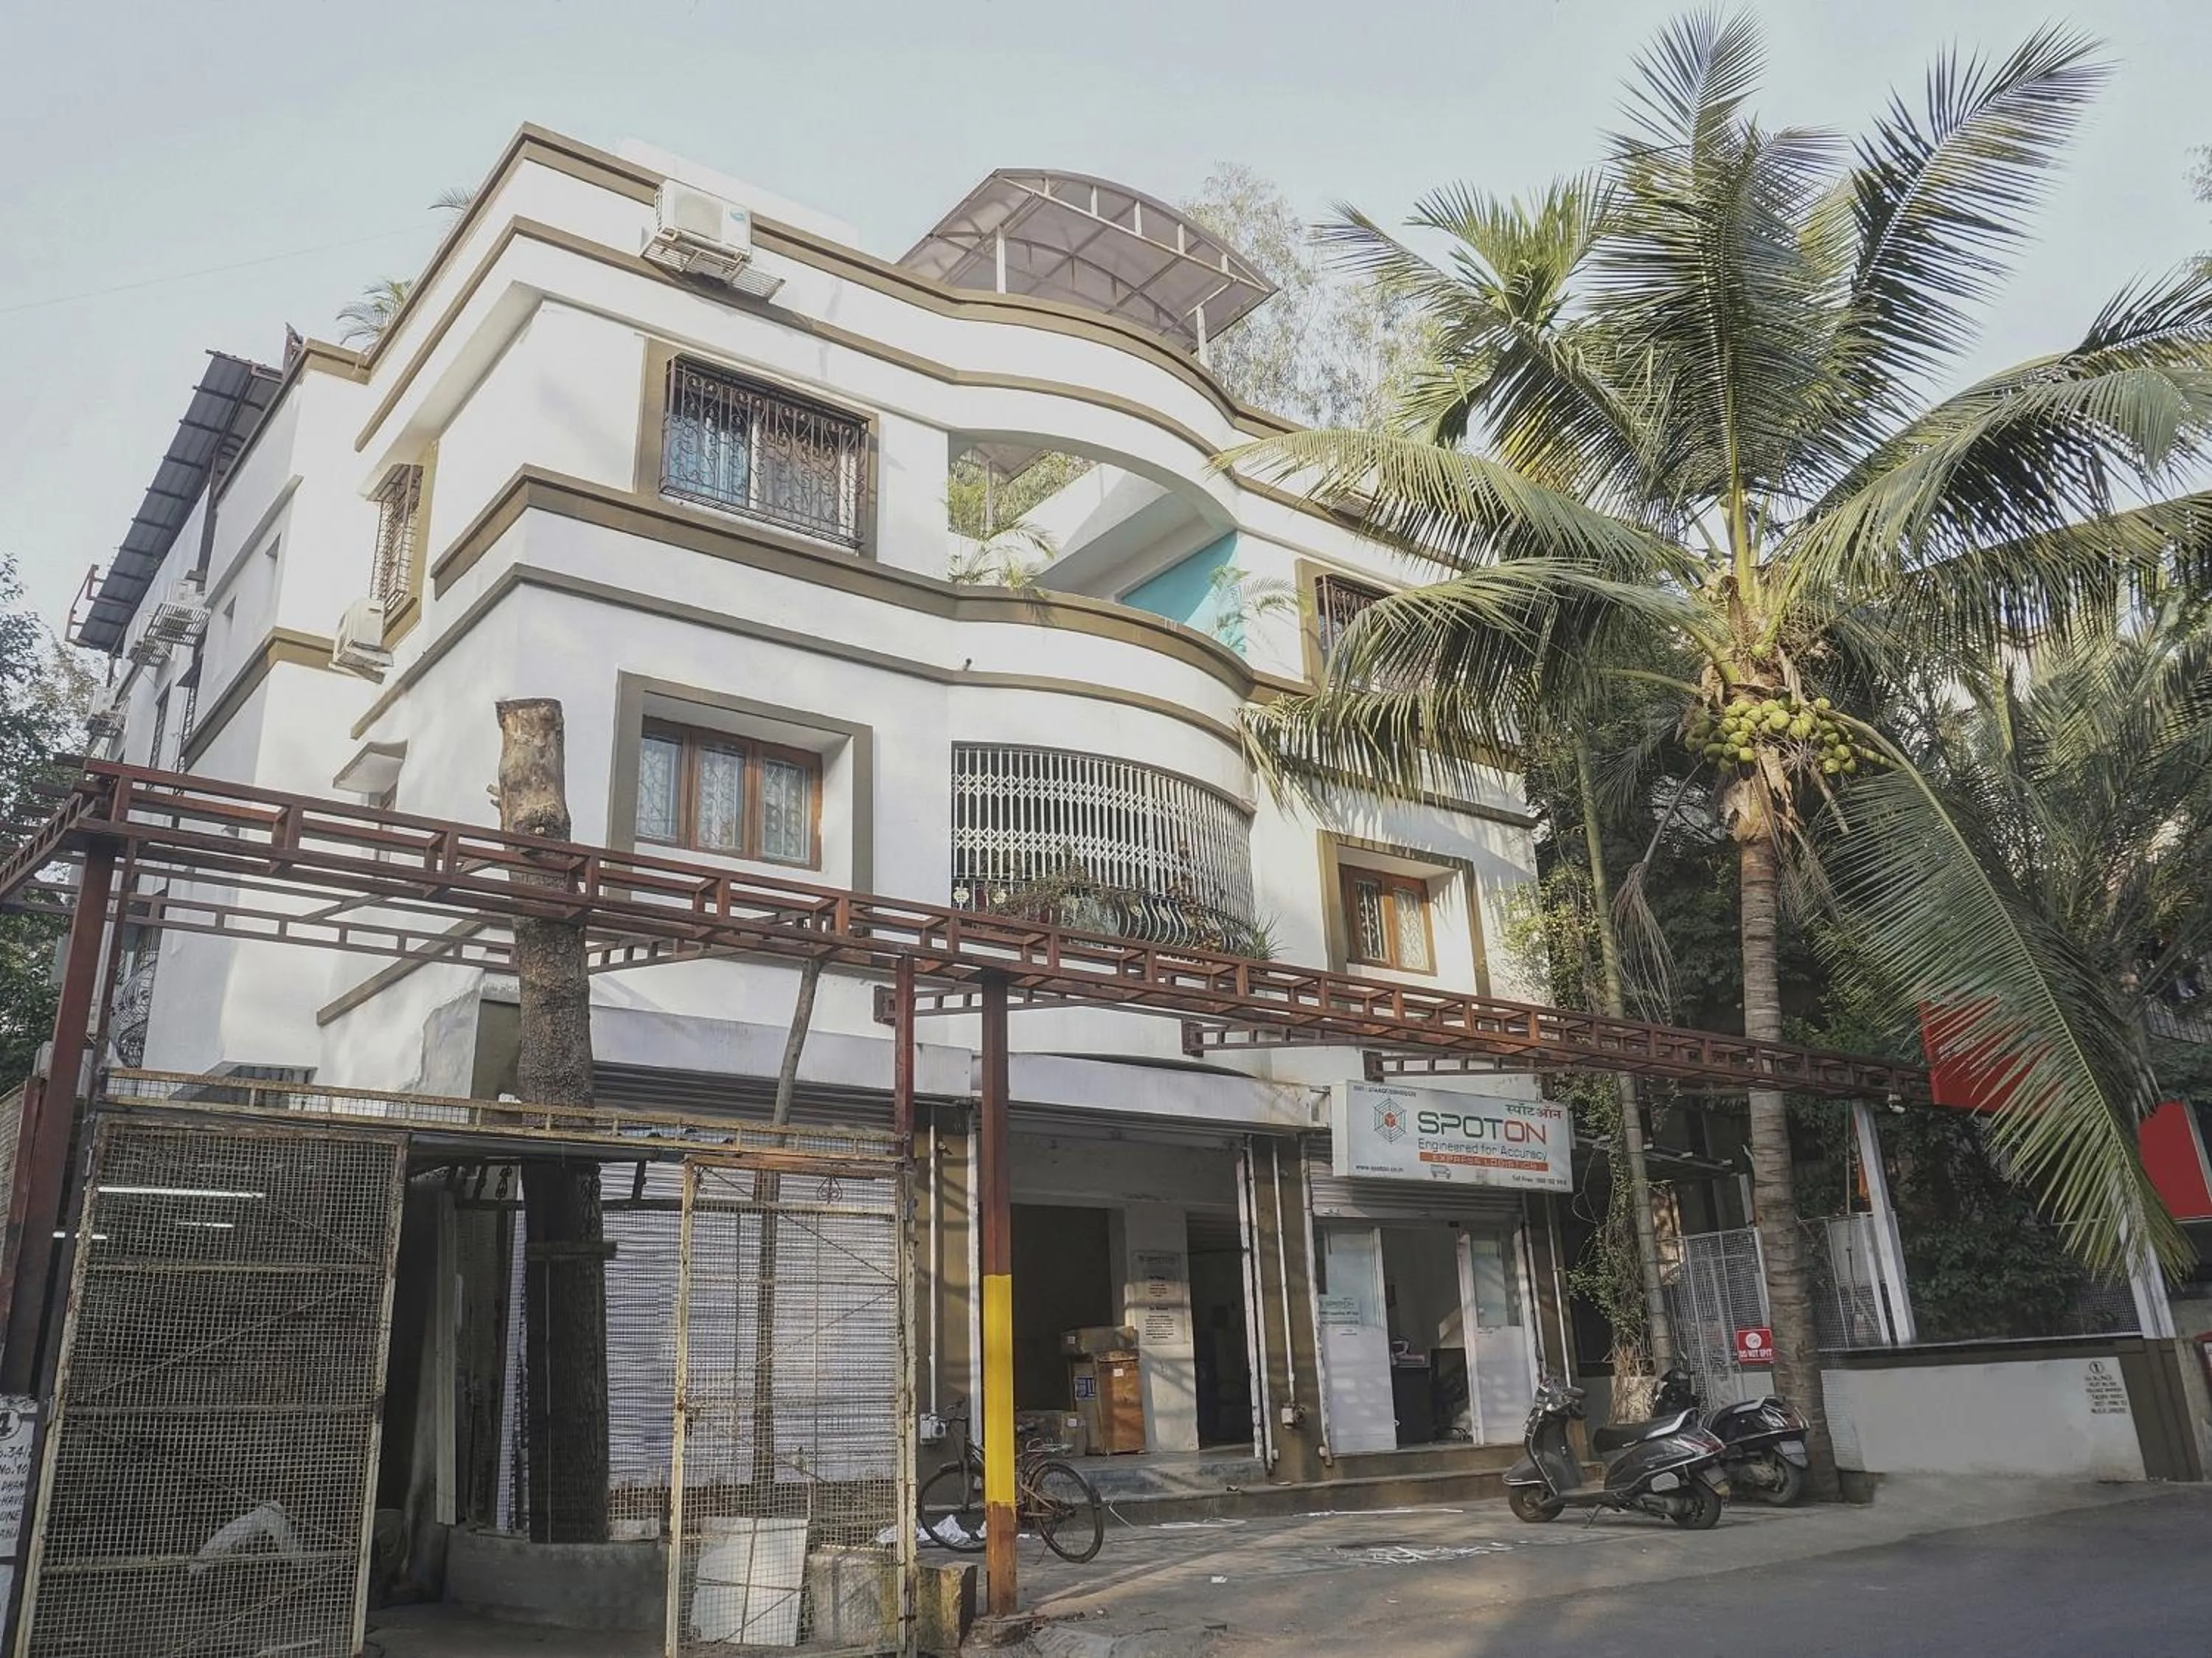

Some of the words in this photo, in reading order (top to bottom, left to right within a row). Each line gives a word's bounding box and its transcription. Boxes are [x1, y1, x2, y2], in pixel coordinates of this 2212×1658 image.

[1417, 1111, 1547, 1145] SPOTON
[1418, 1139, 1479, 1154] Engineered
[1481, 1143, 1498, 1155] for
[1500, 1145, 1548, 1161] Accuracy
